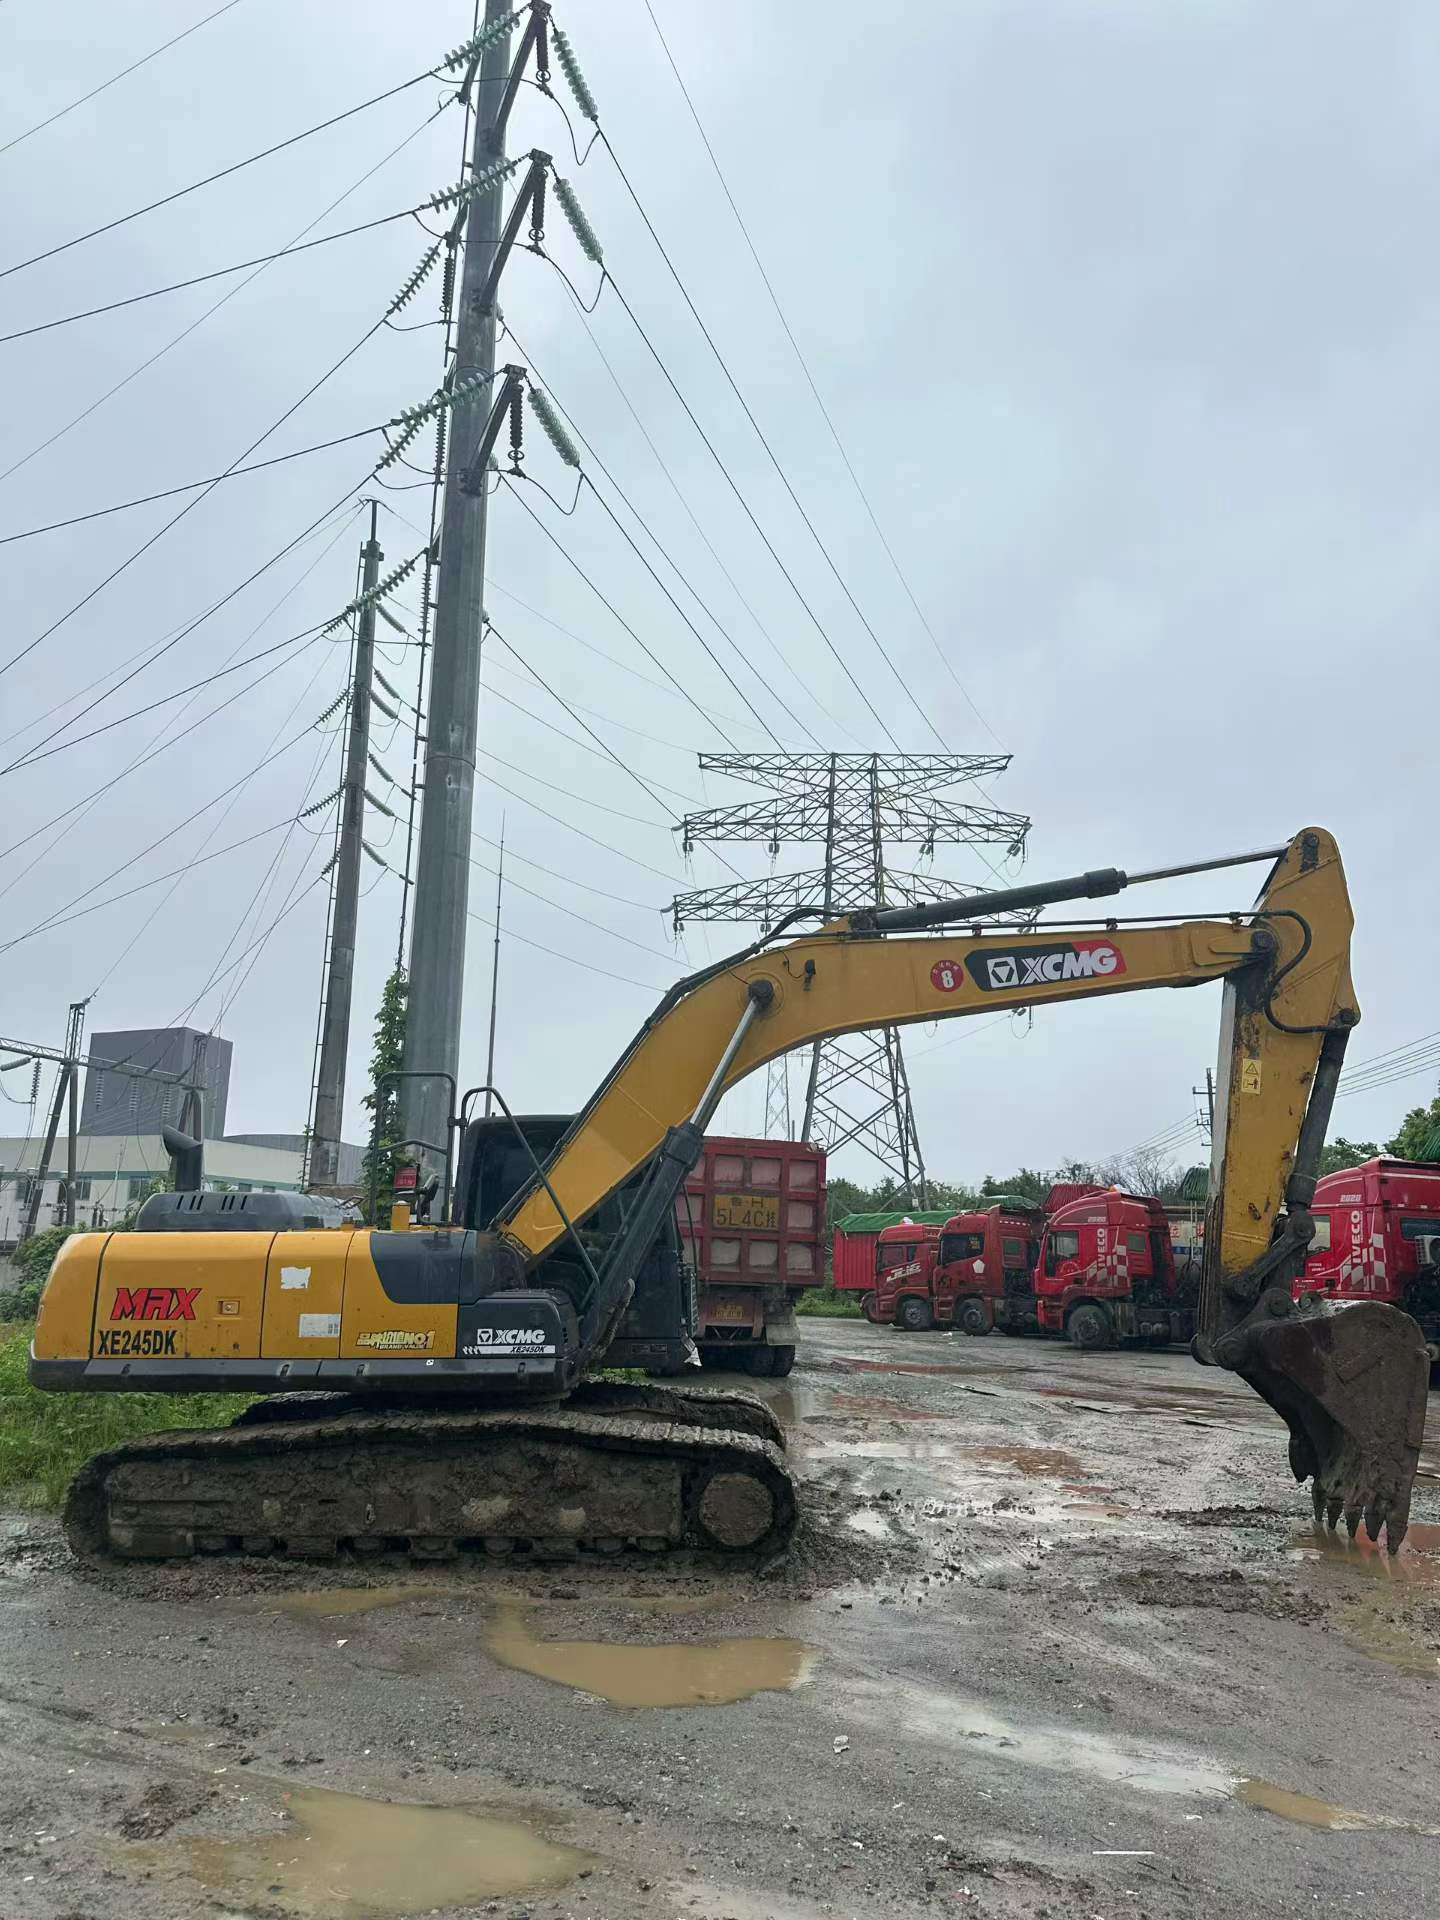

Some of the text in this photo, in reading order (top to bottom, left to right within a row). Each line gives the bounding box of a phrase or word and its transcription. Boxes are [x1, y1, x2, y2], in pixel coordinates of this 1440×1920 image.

[941, 969, 955, 988] 8
[1020, 947, 1117, 984] XCMG
[1097, 1228, 1105, 1267] IVECO
[1351, 1210, 1361, 1263] IVECO
[109, 1287, 203, 1321] MAX
[98, 1330, 178, 1355] XE245DK
[493, 1329, 546, 1344] XCMG
